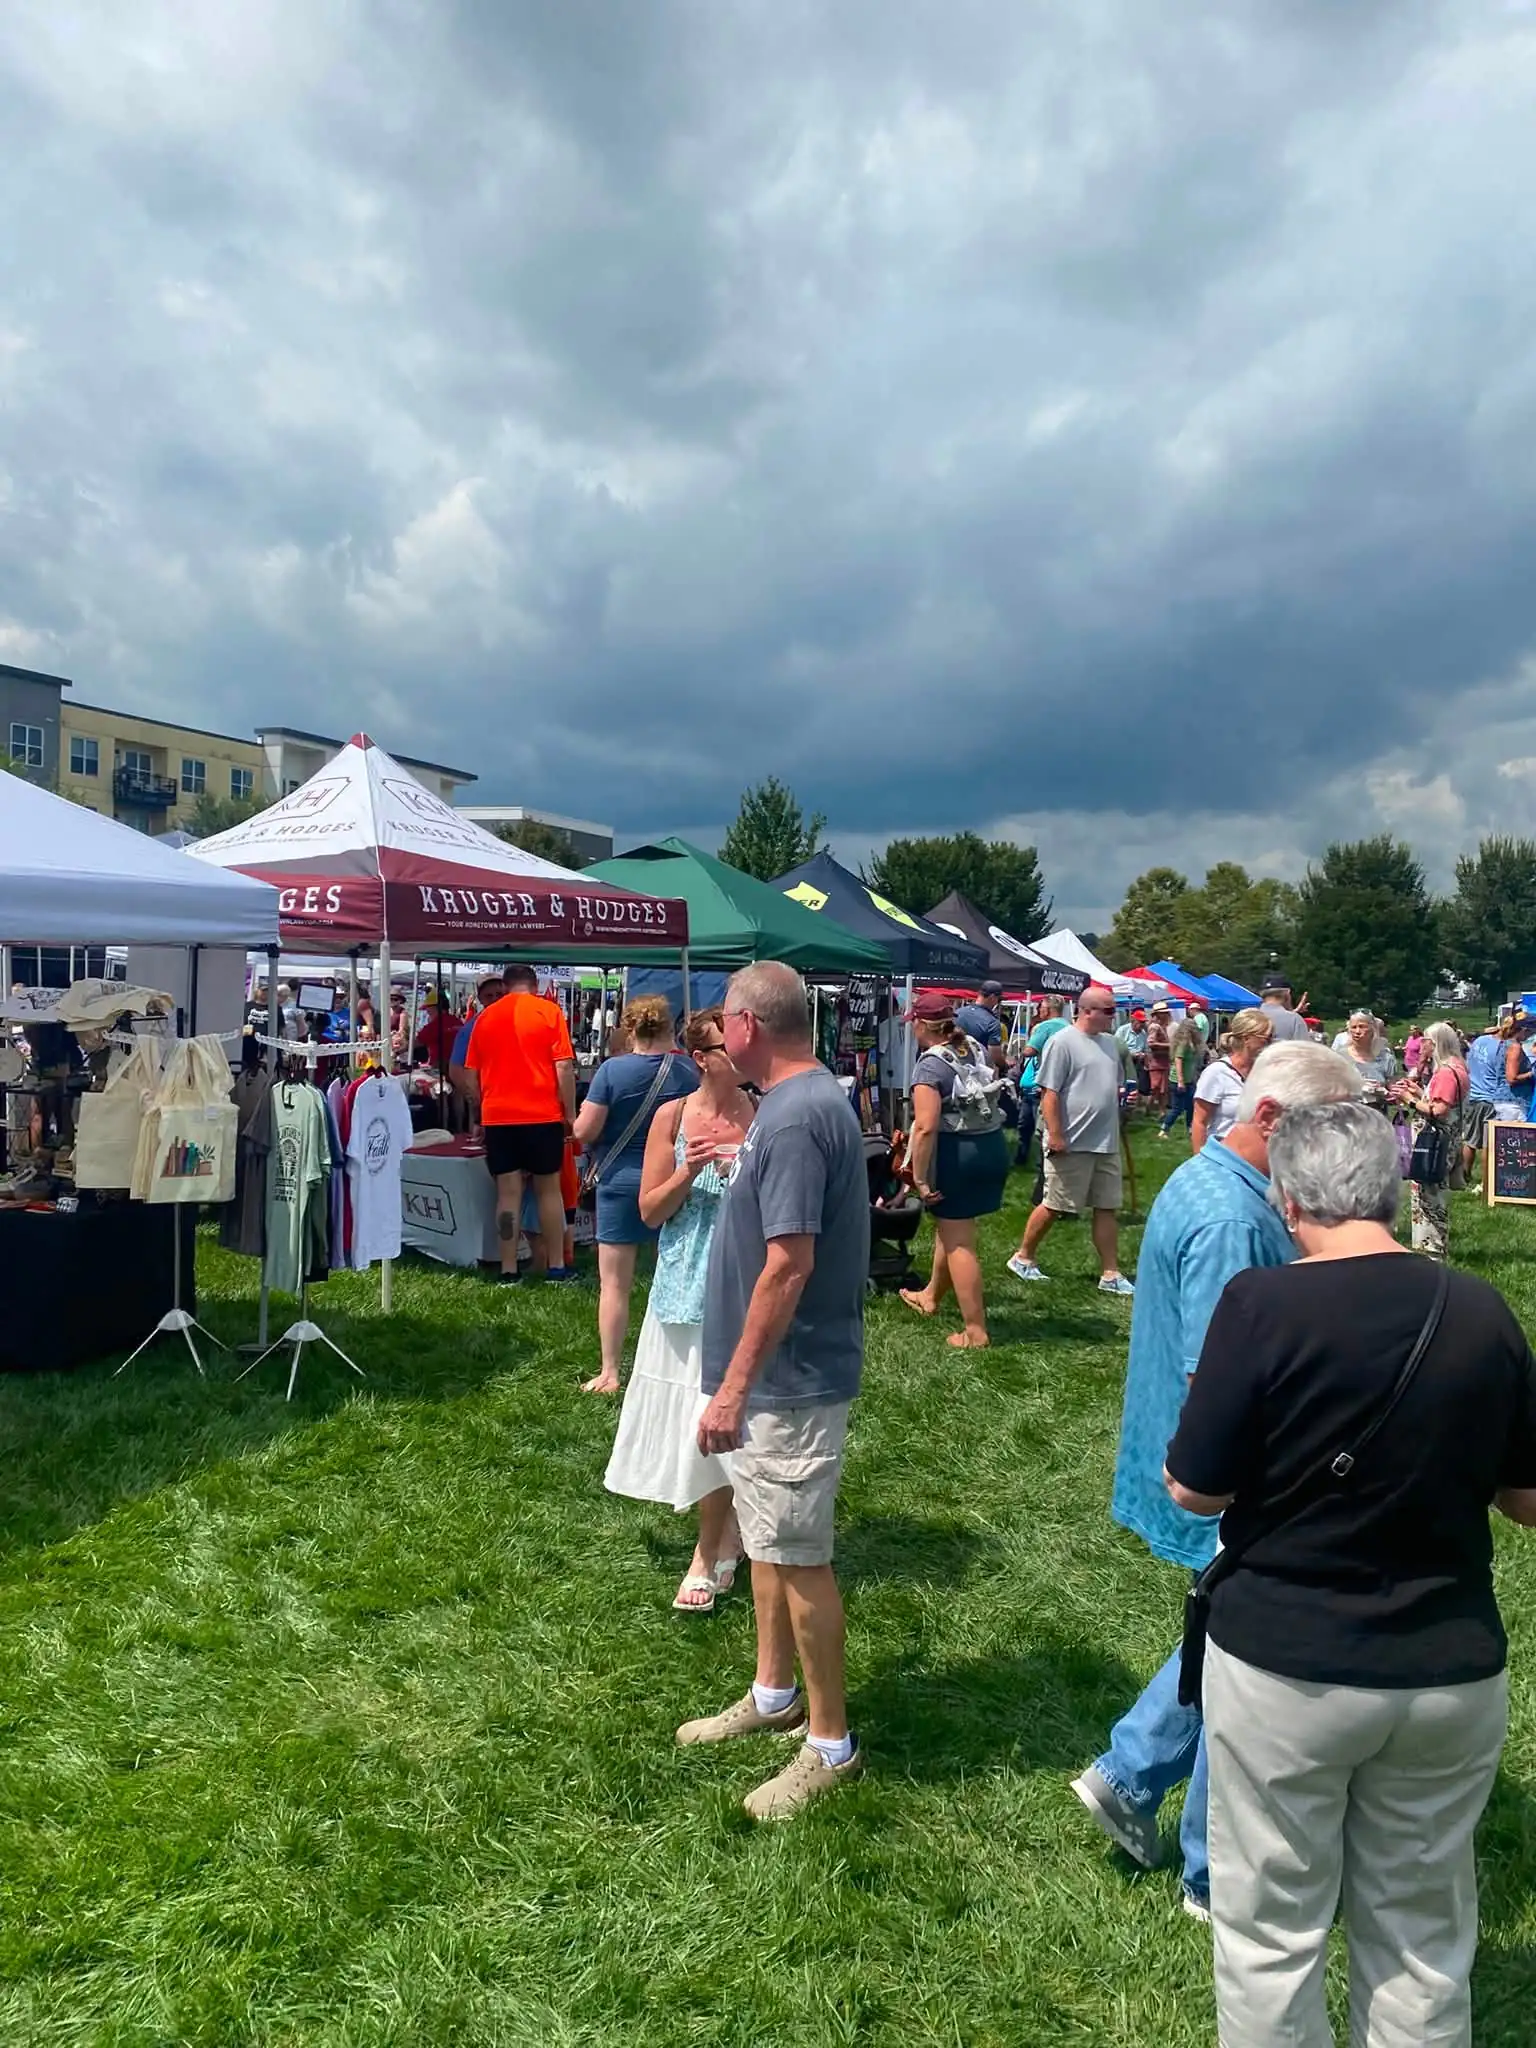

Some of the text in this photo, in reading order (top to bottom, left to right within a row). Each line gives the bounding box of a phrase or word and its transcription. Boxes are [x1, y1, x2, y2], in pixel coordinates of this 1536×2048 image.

[276, 821, 357, 836] HODGES
[386, 820, 459, 841] KRUGER
[278, 885, 343, 913] GES
[418, 885, 666, 924] KRUGER & HODGES
[403, 1193, 445, 1221] KH
